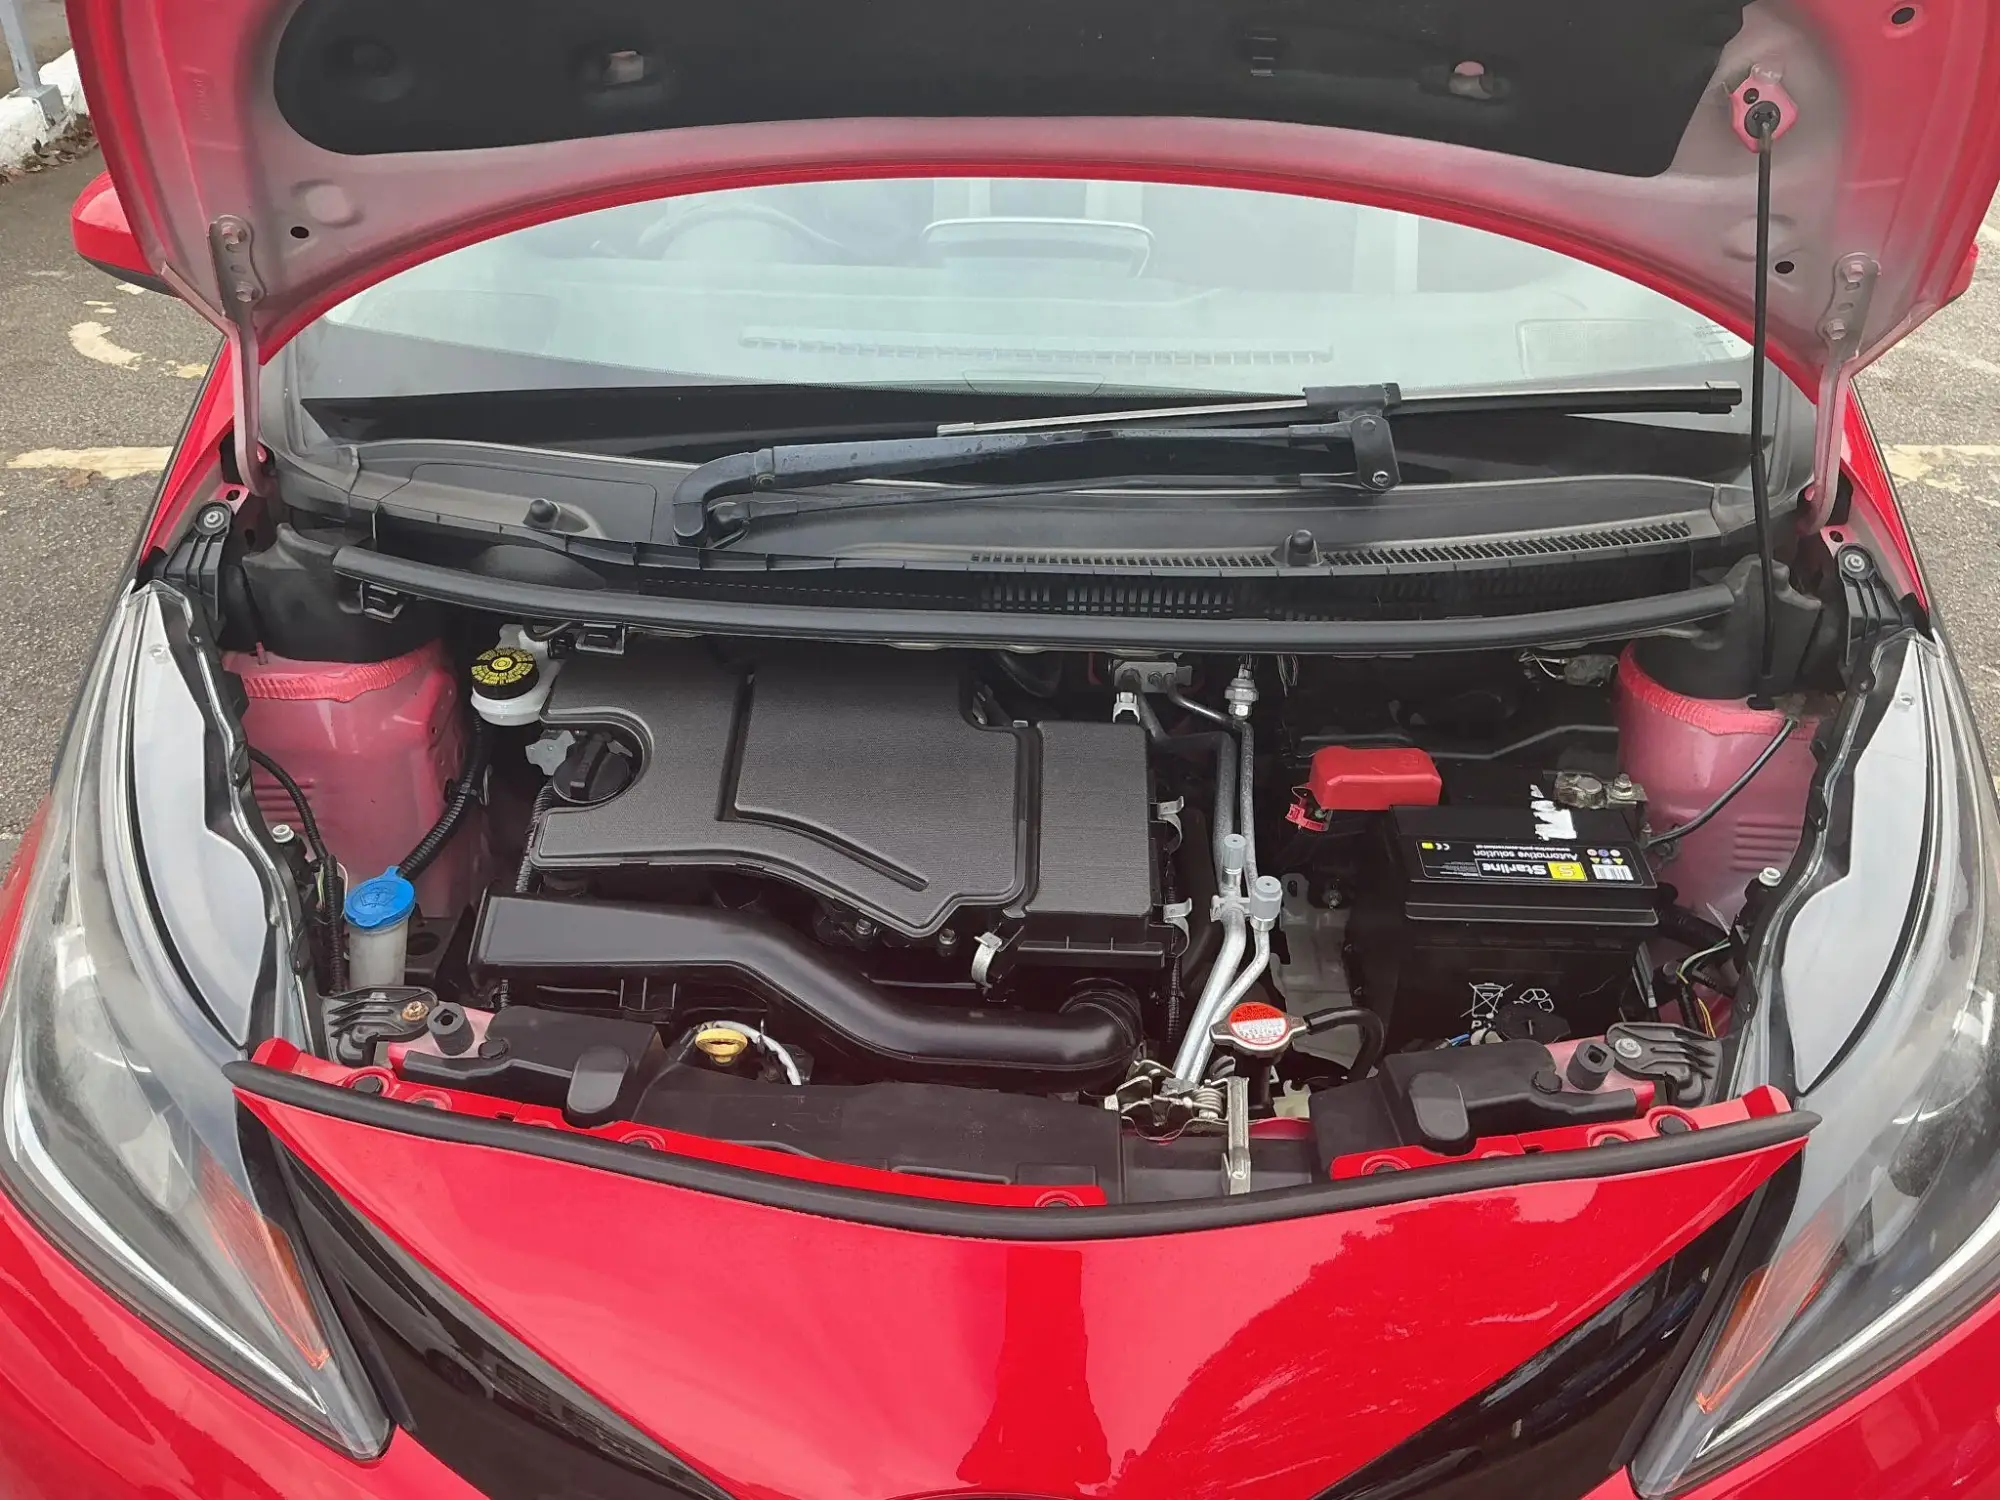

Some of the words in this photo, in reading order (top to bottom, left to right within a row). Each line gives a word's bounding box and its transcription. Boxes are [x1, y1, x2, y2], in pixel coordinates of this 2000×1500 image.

[1473, 849, 1515, 858] solution
[1517, 850, 1578, 861] Automotive
[1481, 862, 1547, 876] Starline
